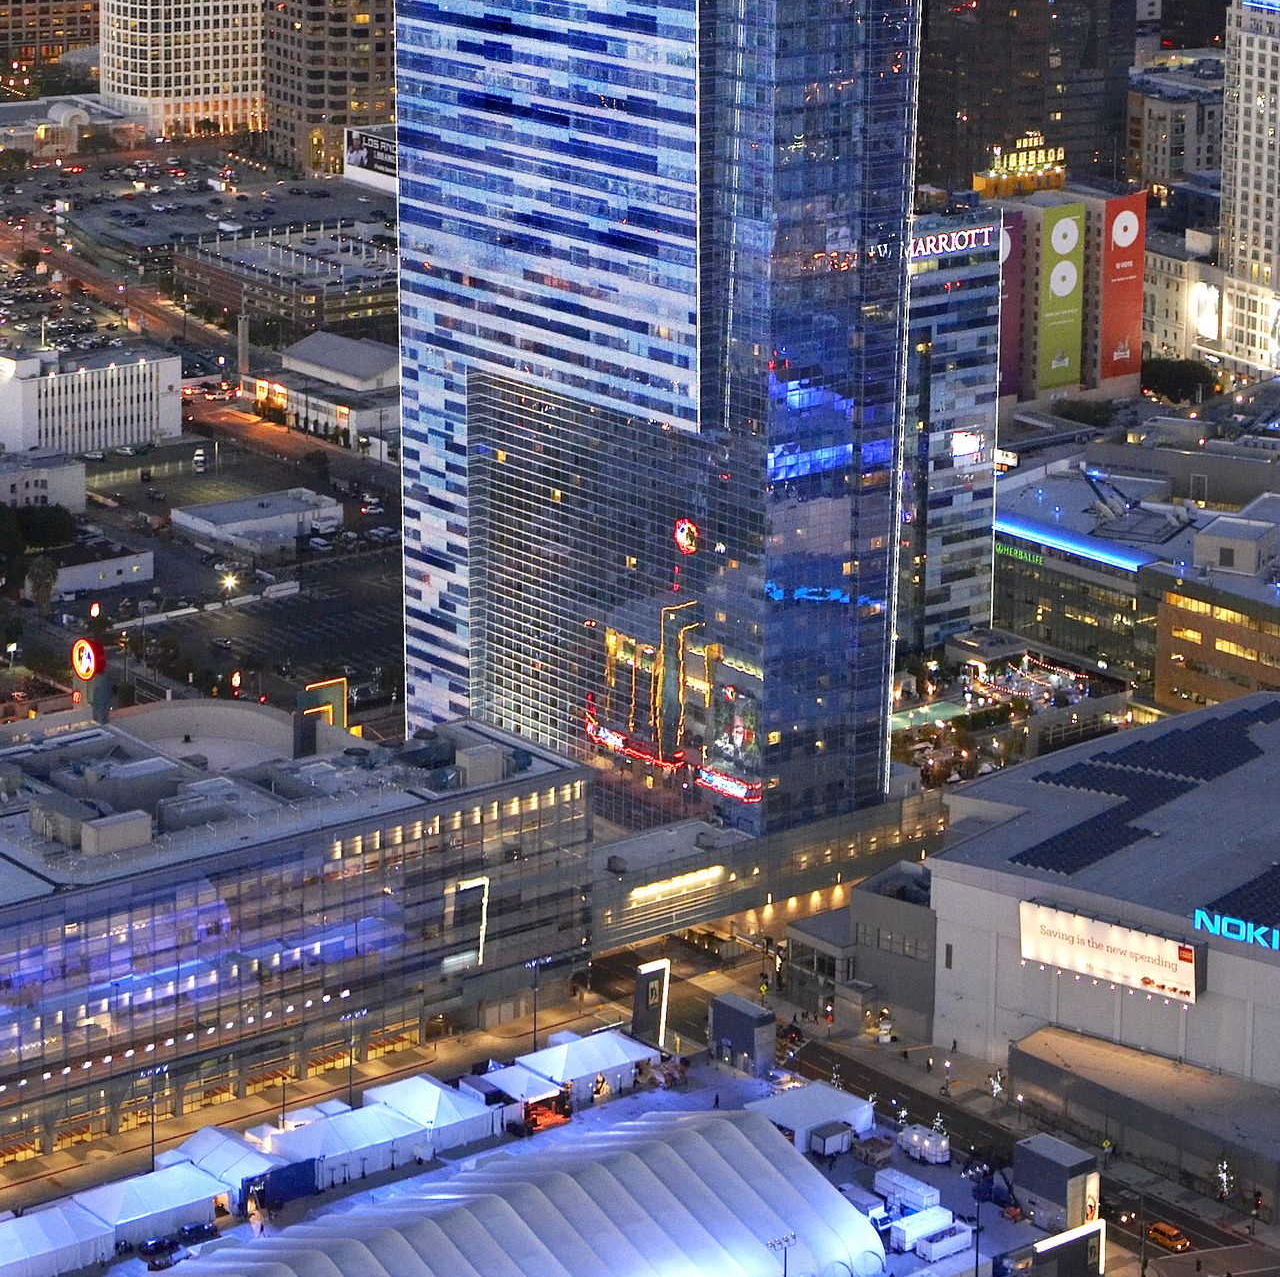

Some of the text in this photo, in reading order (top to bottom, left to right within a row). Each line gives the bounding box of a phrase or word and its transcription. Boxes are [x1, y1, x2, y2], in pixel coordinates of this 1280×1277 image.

[1016, 135, 1045, 150] HOTEL
[900, 225, 994, 261] MARRIOTT
[1003, 545, 1045, 566] HERBALIFE
[1040, 924, 1075, 945] Saving
[1077, 937, 1086, 946] is
[1087, 937, 1105, 951] the
[1106, 944, 1128, 957] new
[1129, 952, 1178, 973] spending
